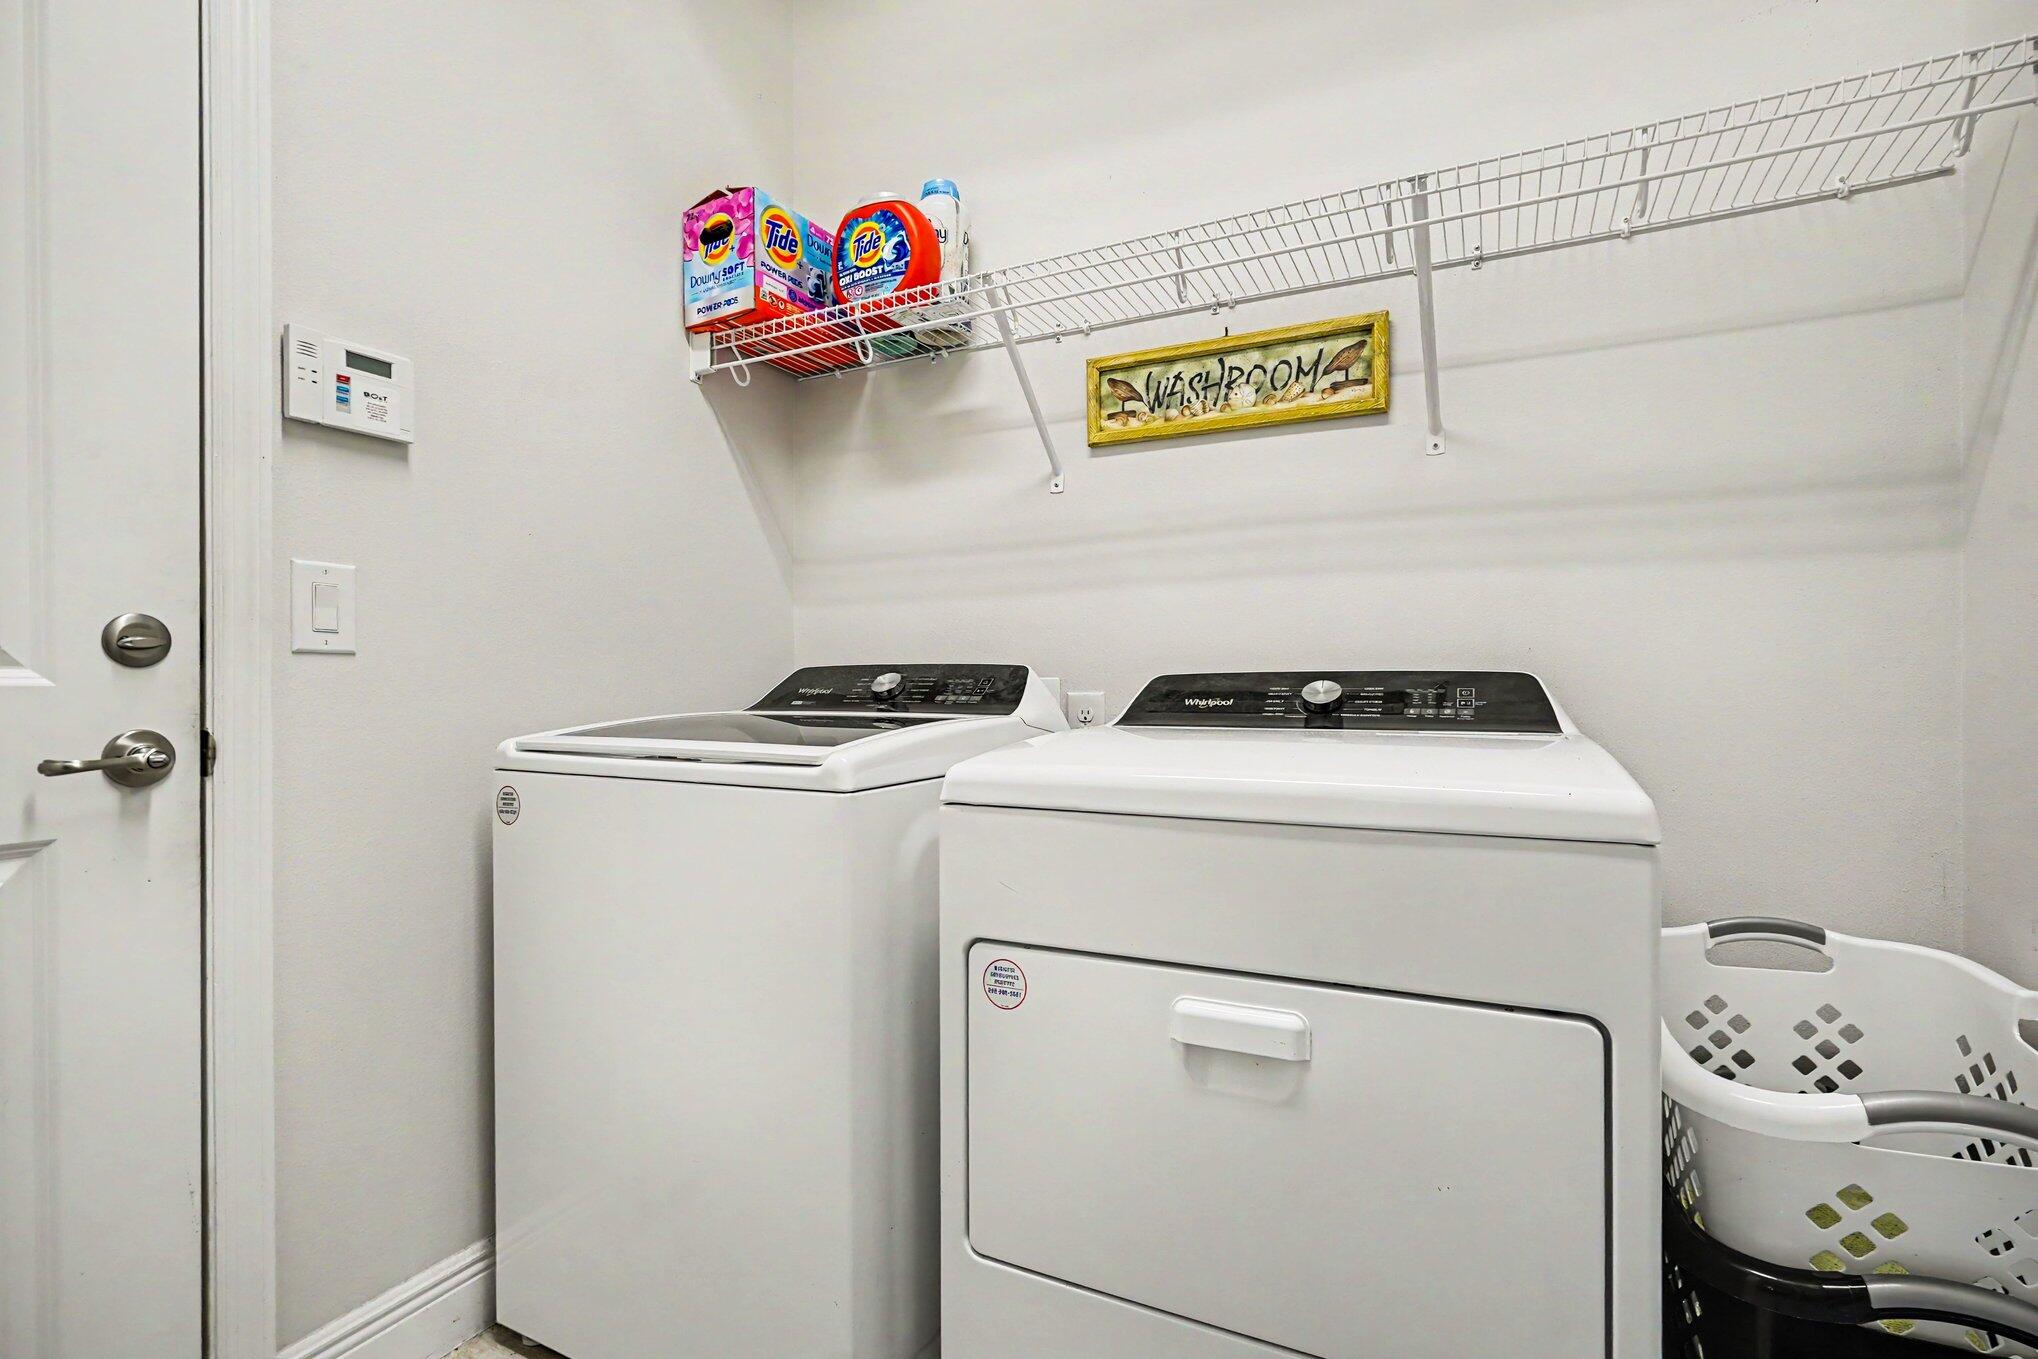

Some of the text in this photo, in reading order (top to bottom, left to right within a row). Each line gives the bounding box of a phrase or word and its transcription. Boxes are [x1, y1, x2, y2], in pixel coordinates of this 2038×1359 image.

[765, 218, 798, 254] Tide
[807, 233, 832, 258] Down
[853, 231, 882, 262] Tide
[690, 267, 721, 288] Downy
[722, 261, 745, 277] SOFT
[760, 260, 788, 282] POWER
[839, 274, 853, 287] OXI
[853, 265, 884, 281] BOOST
[697, 301, 722, 316] POWER
[1145, 348, 1324, 414] WASHROOM
[798, 687, 834, 697] Whirlpool
[1184, 697, 1234, 709] Whirlpool
